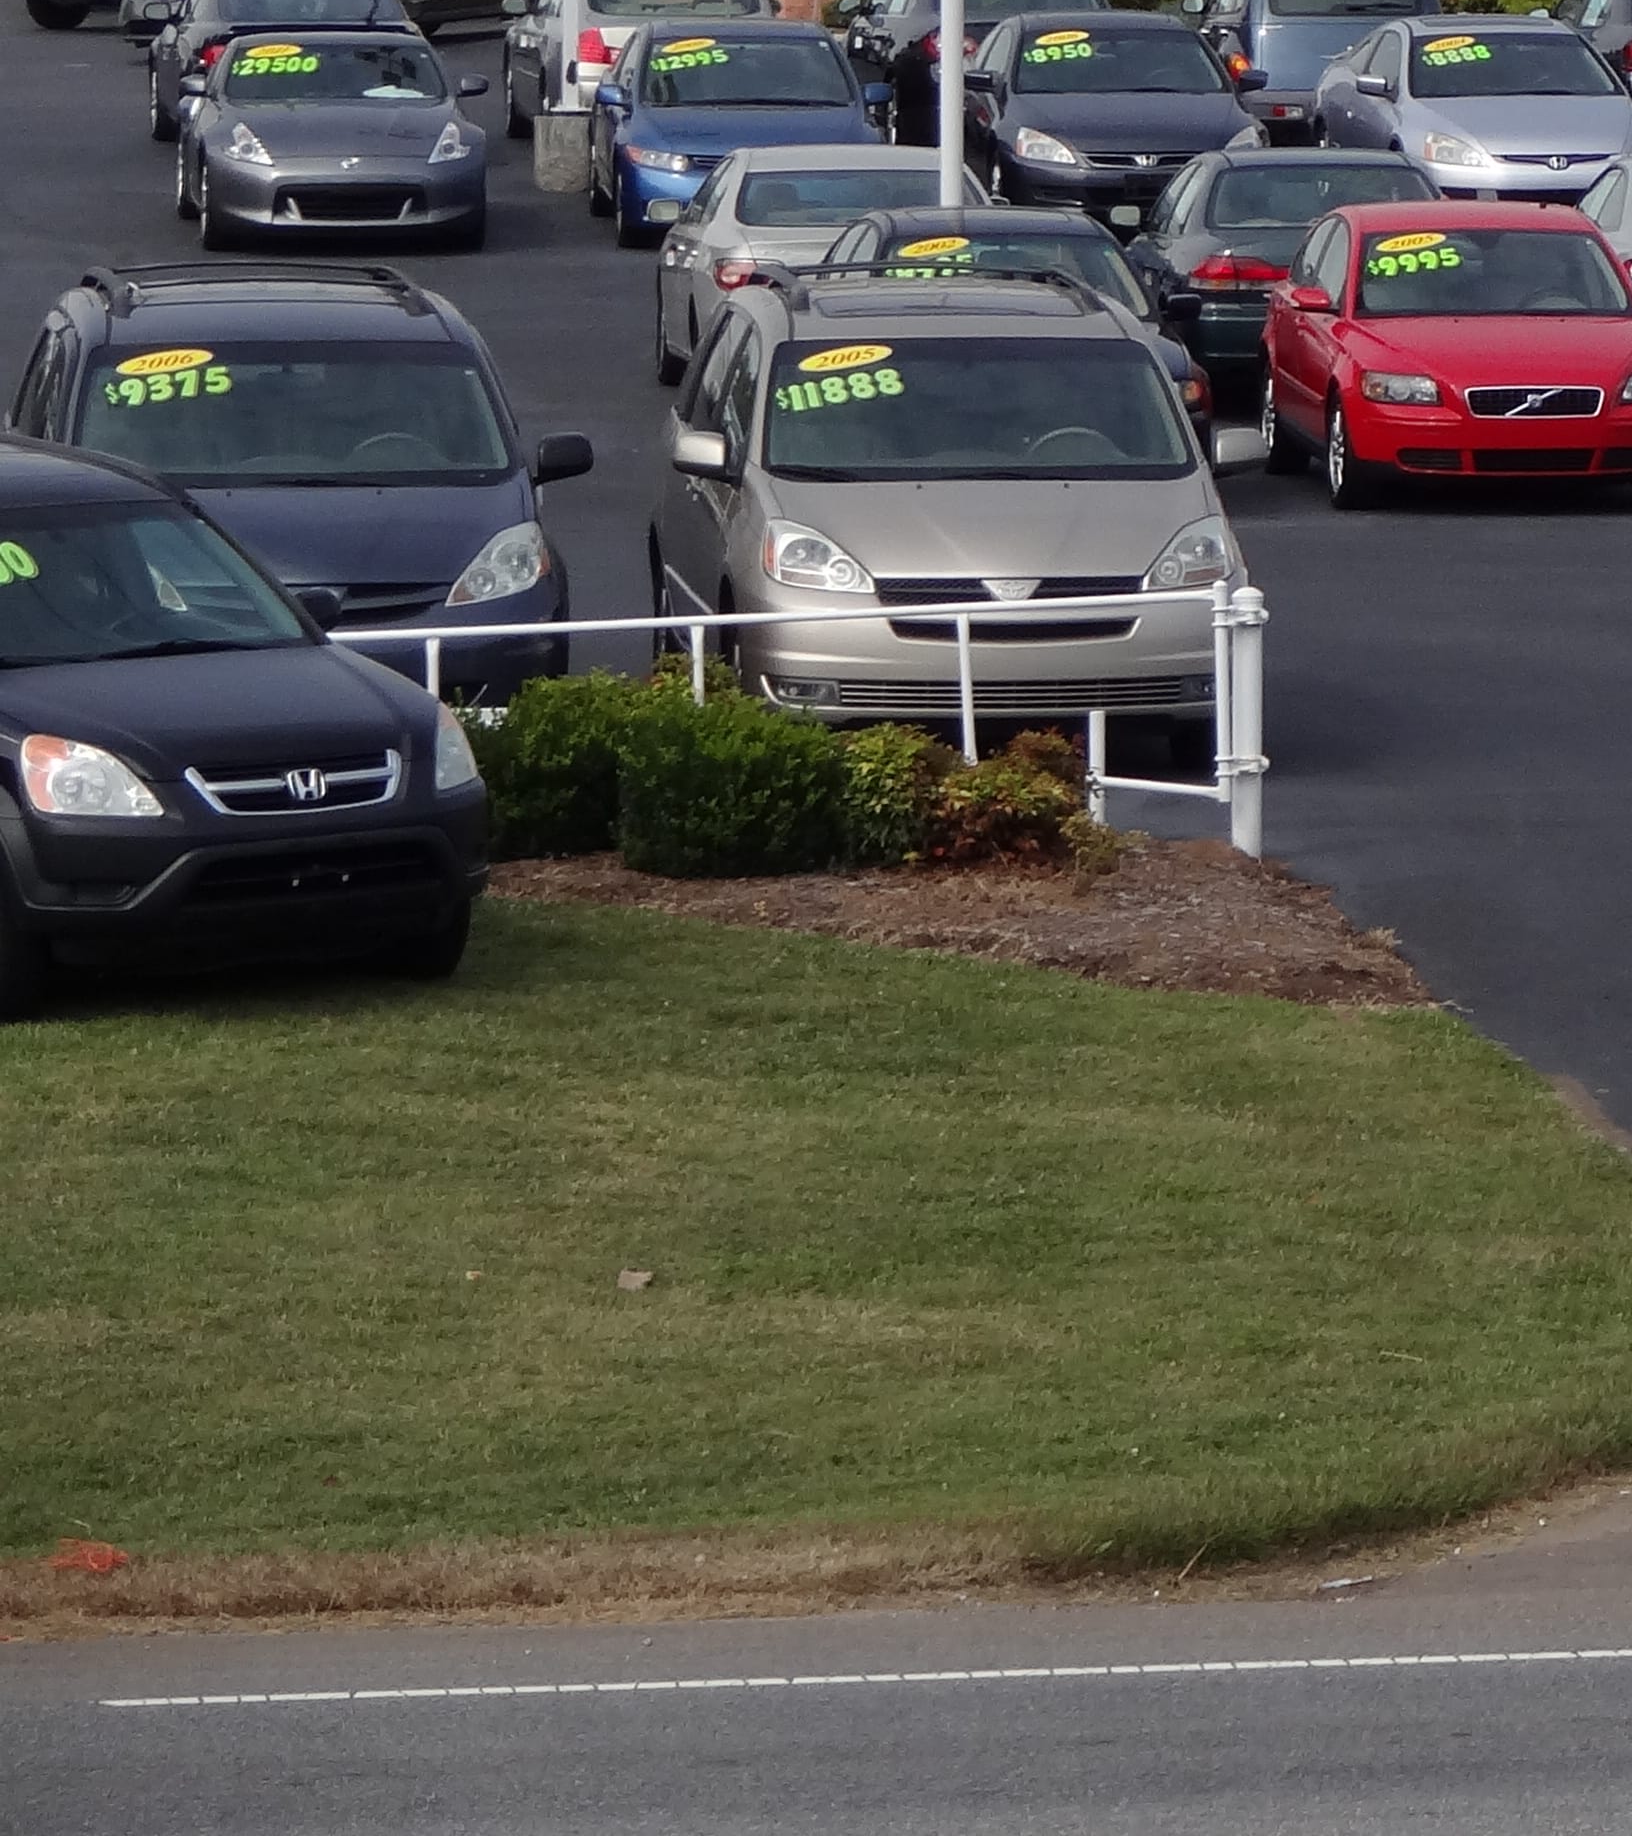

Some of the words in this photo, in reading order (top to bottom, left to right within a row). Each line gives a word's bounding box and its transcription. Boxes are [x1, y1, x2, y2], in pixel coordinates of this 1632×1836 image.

[650, 48, 729, 71] $12995
[1024, 43, 1092, 62] $8950
[232, 56, 319, 75] $29500
[1367, 247, 1461, 276] $9995
[133, 354, 194, 373] 2006
[816, 348, 876, 369] 2005
[105, 365, 233, 406] $9375
[776, 368, 905, 411] $11888
